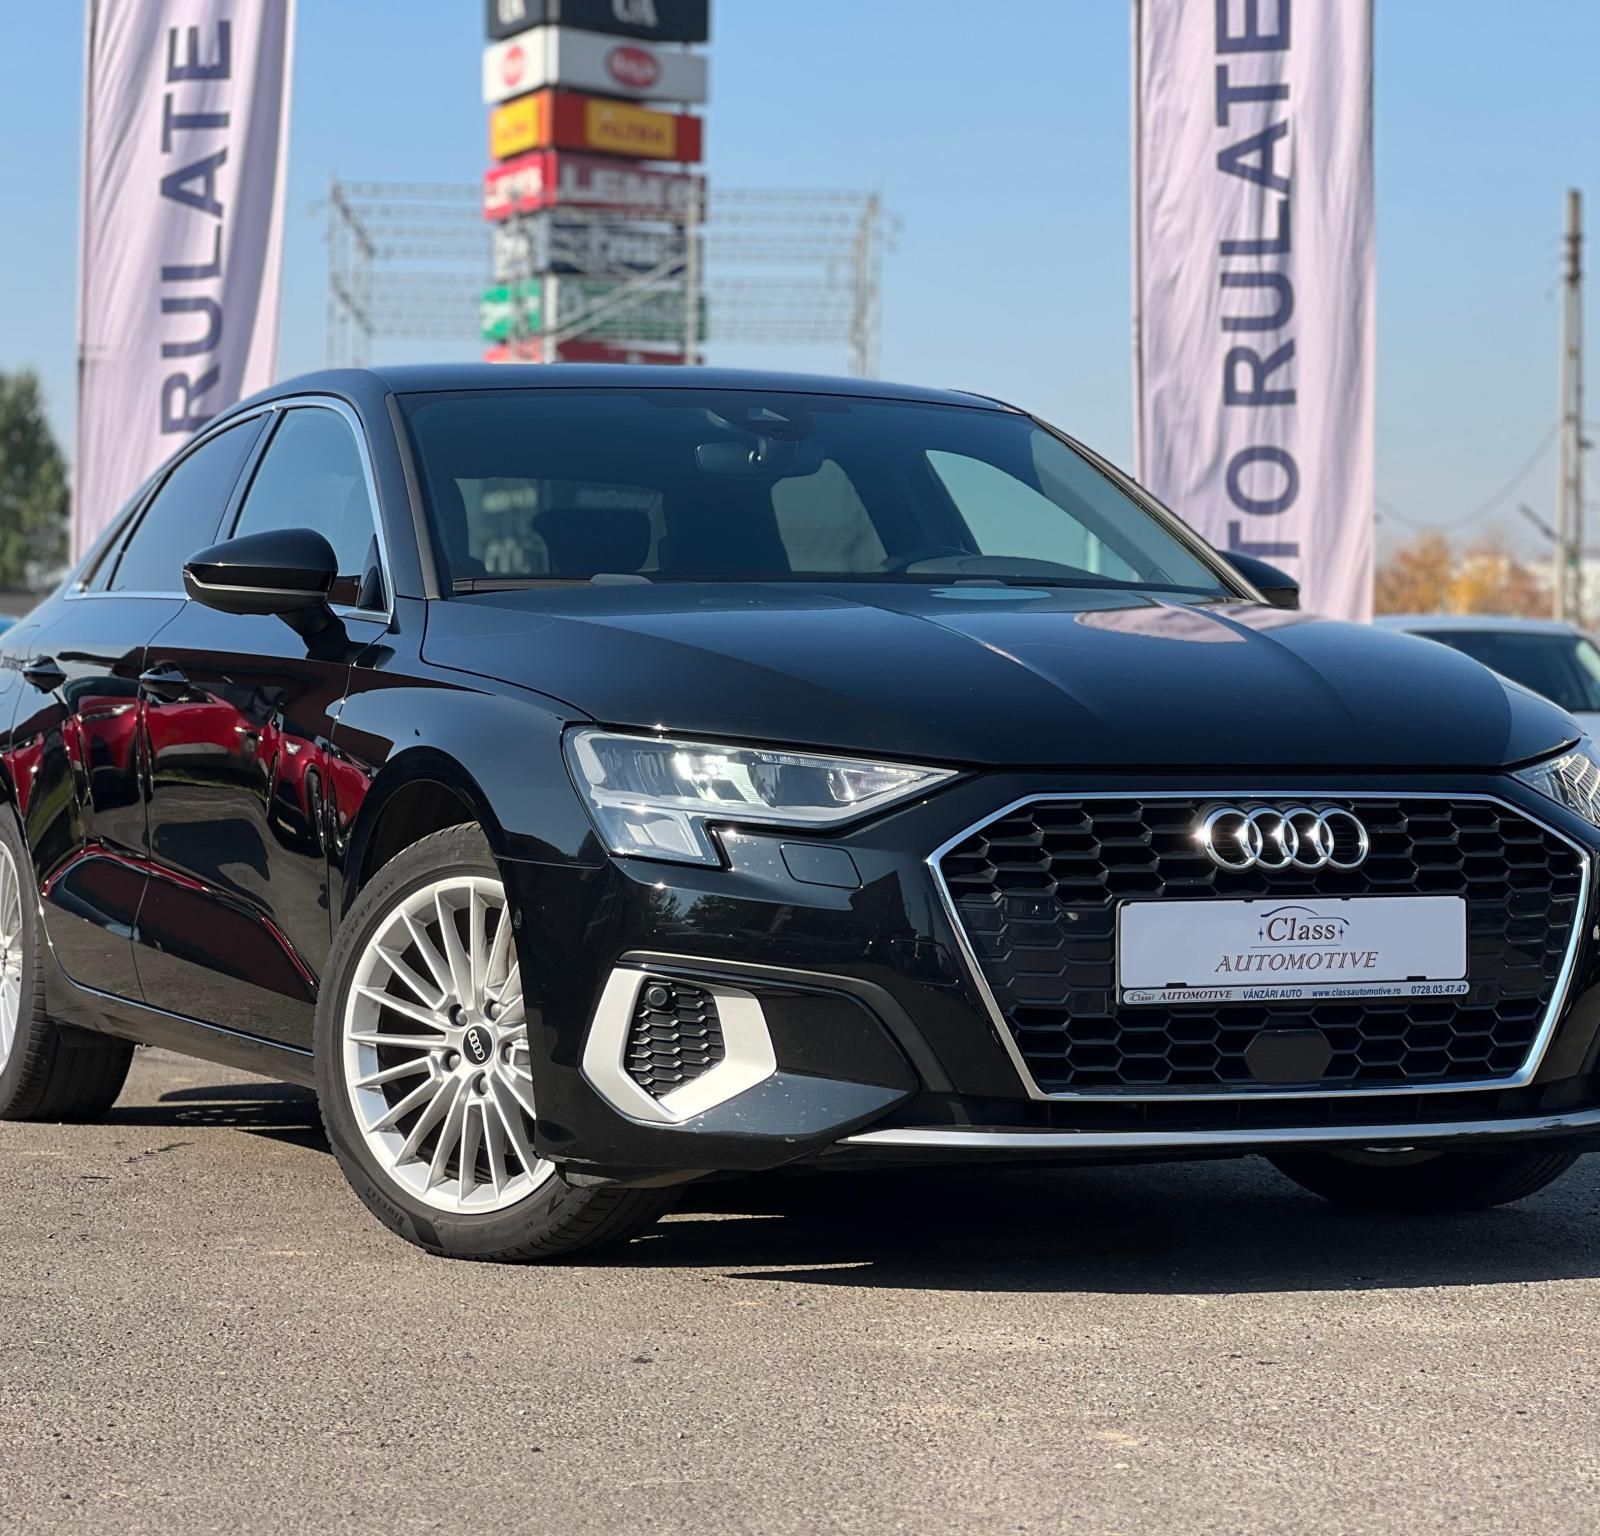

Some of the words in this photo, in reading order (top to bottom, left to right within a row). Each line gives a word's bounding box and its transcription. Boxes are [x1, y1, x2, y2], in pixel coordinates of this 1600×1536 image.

[1214, 0, 1298, 407] RULATE
[160, 20, 231, 436] RULATE
[1266, 917, 1336, 942] Class
[1214, 951, 1379, 973] AUTOMOTIVE
[1158, 989, 1232, 1001] AUTOMOTIVE
[1279, 988, 1303, 998] AUTO
[1312, 986, 1402, 997] www.classautomotive.ro
[1411, 984, 1467, 995] 0728.03.47.47
